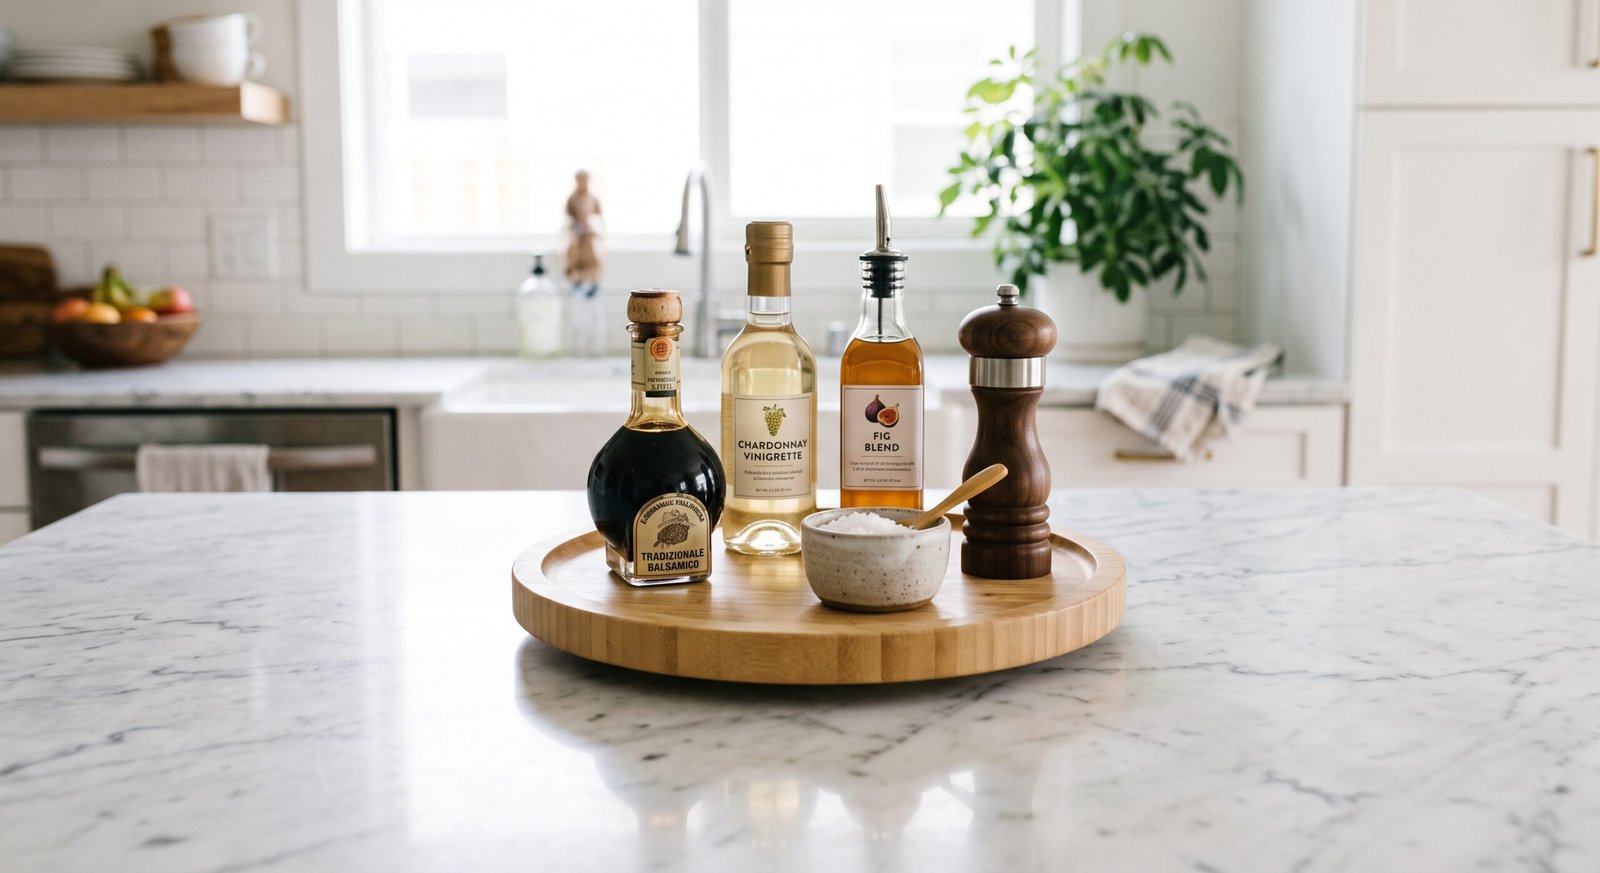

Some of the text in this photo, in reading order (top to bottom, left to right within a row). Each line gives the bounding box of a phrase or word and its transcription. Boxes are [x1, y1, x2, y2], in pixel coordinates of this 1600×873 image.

[873, 432, 891, 440] FIG
[737, 439, 808, 450] CHARDONNAY
[864, 443, 900, 452] BLEND
[743, 451, 803, 461] VINIGRETTE
[641, 548, 705, 561] TRADIZIONALE
[647, 559, 700, 572] BALSAMICO
